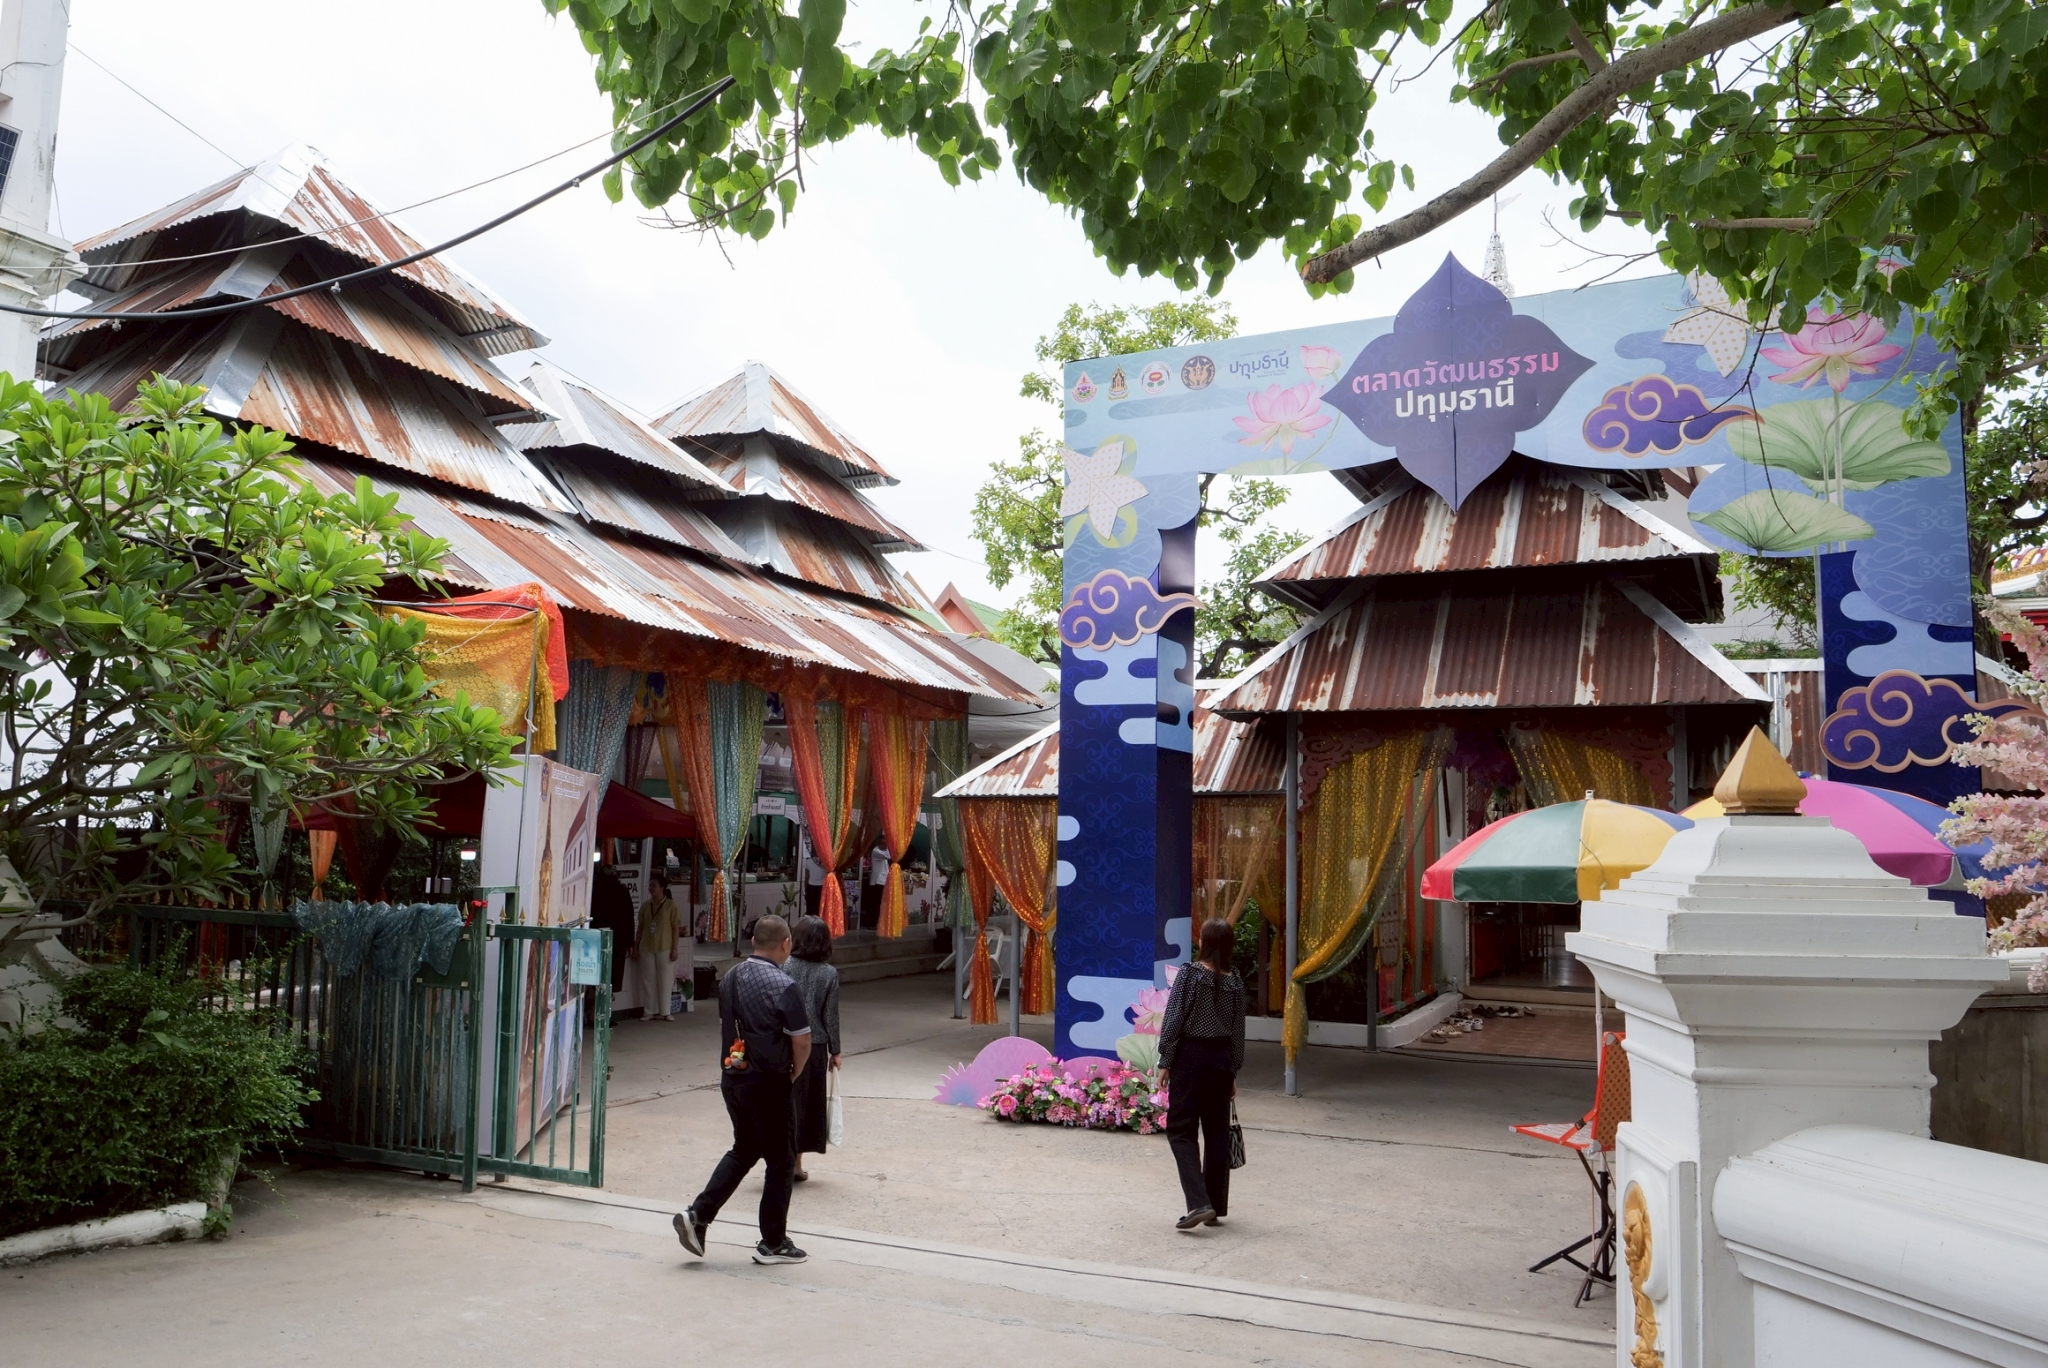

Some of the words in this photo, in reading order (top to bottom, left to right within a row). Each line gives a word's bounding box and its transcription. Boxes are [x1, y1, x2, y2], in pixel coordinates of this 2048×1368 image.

[1352, 352, 1559, 394] ตลาดวัฒนธรรม
[1395, 377, 1515, 423] ปทุมธานี
